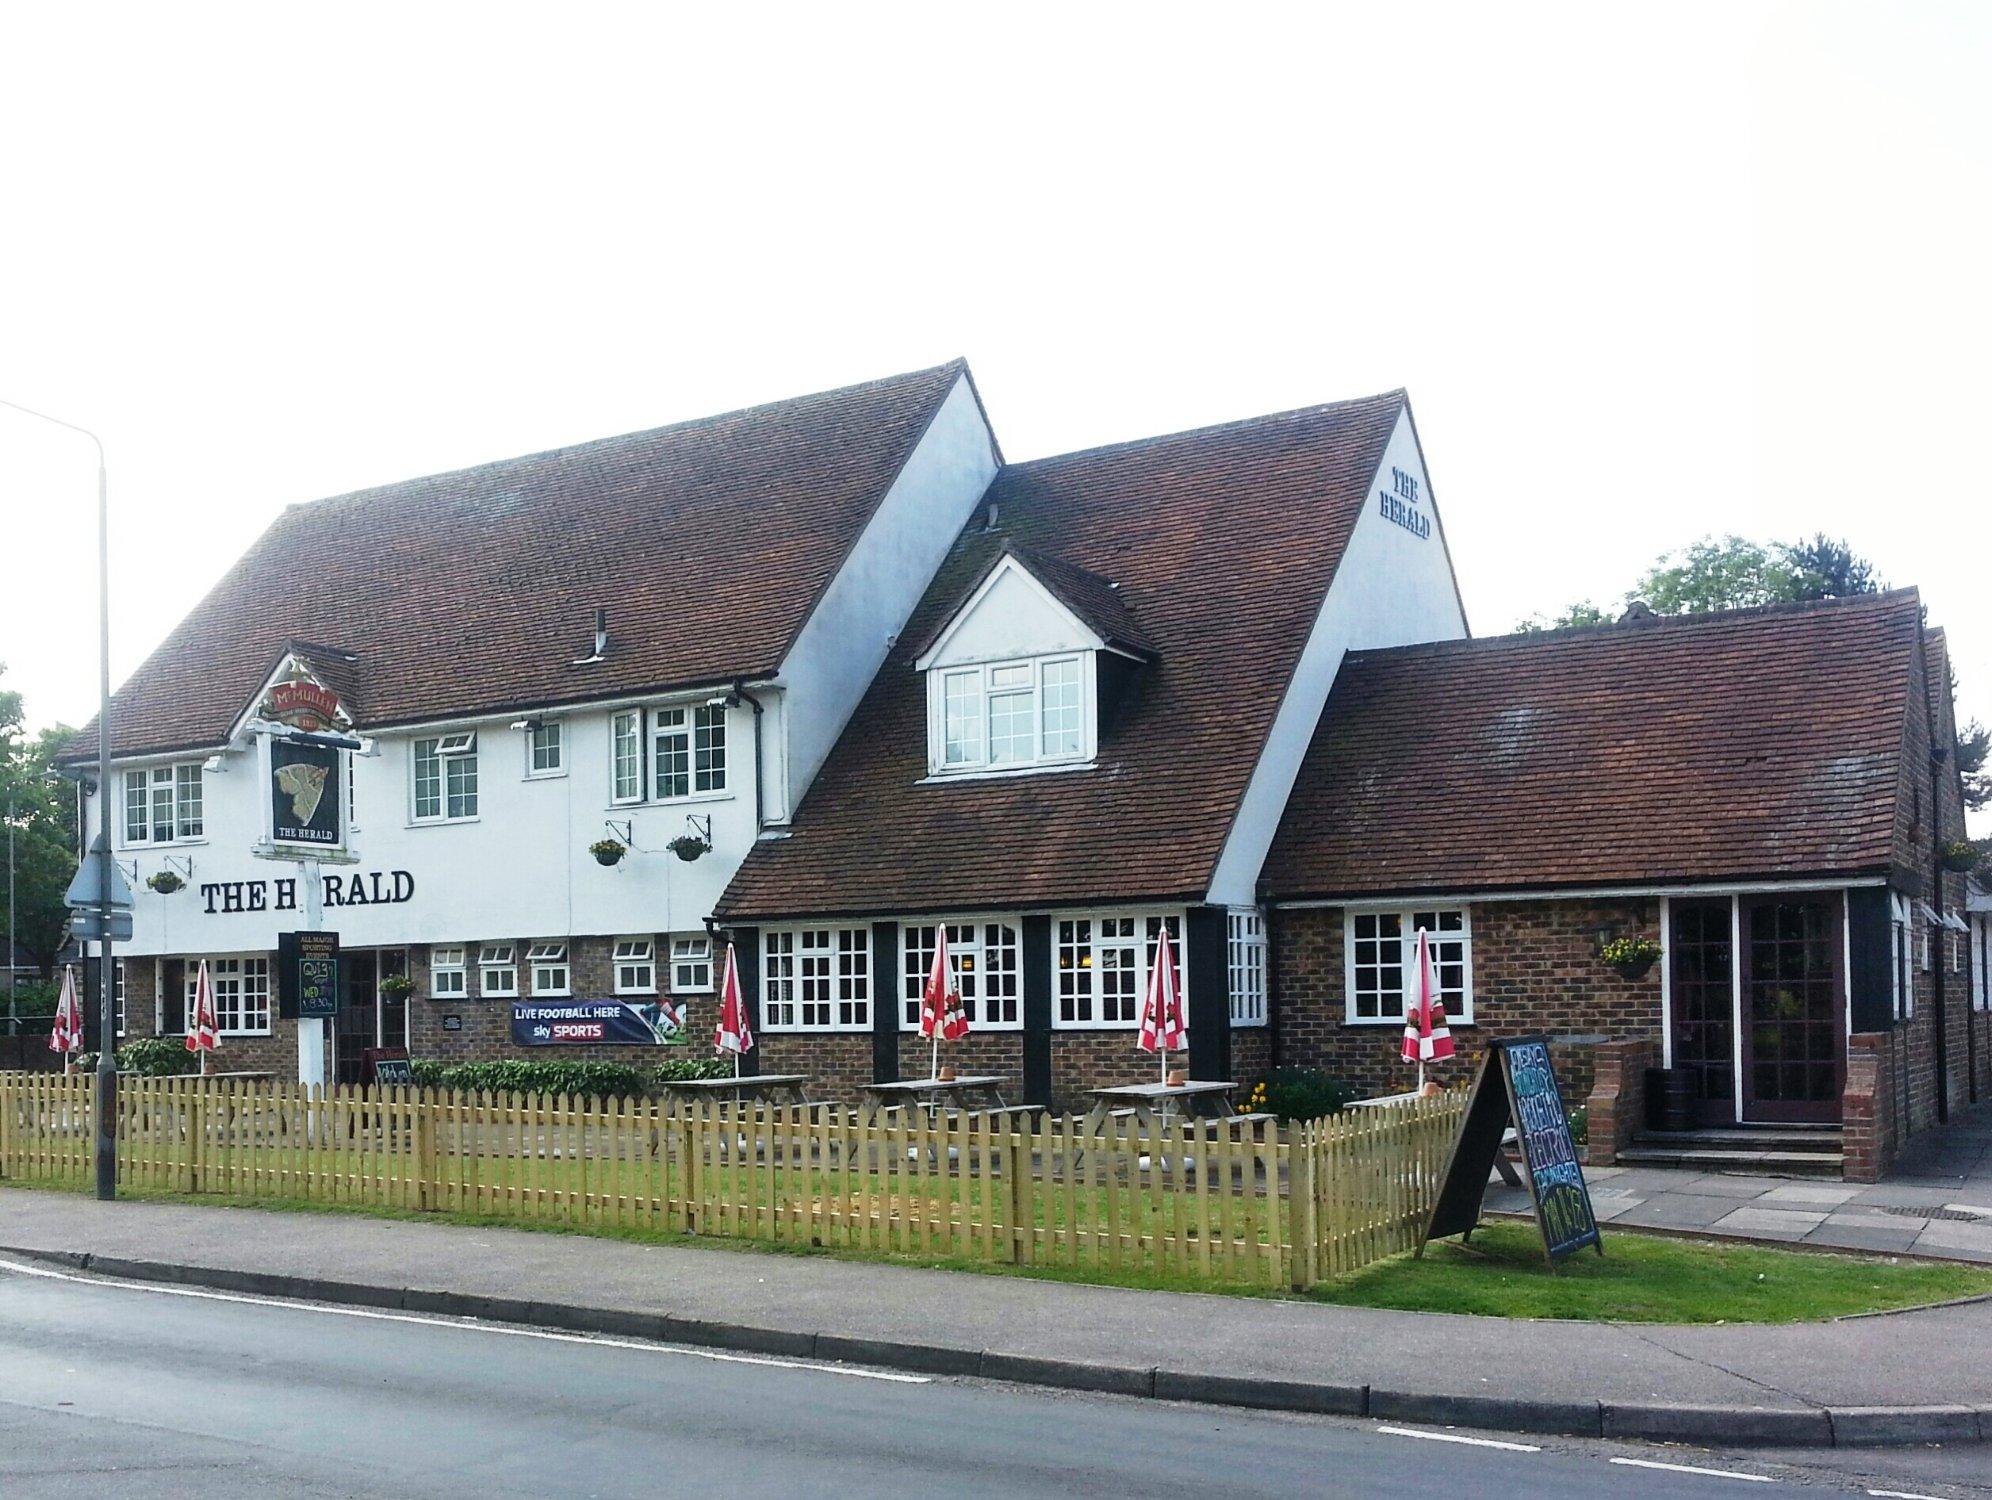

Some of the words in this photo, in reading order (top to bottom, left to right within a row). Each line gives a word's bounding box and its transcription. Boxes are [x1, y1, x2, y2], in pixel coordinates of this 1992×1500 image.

[1392, 465, 1419, 503] THE
[1379, 490, 1431, 540] HERALD
[279, 827, 296, 837] THE
[298, 828, 333, 840] HERALD
[200, 880, 267, 914] THE
[273, 870, 415, 911] HRALD
[515, 1008, 537, 1019] LIVE
[538, 1007, 592, 1019] FOOTBALL
[593, 1006, 620, 1018] HERE
[533, 1024, 551, 1038] sky
[554, 1024, 602, 1037] SPORTS
